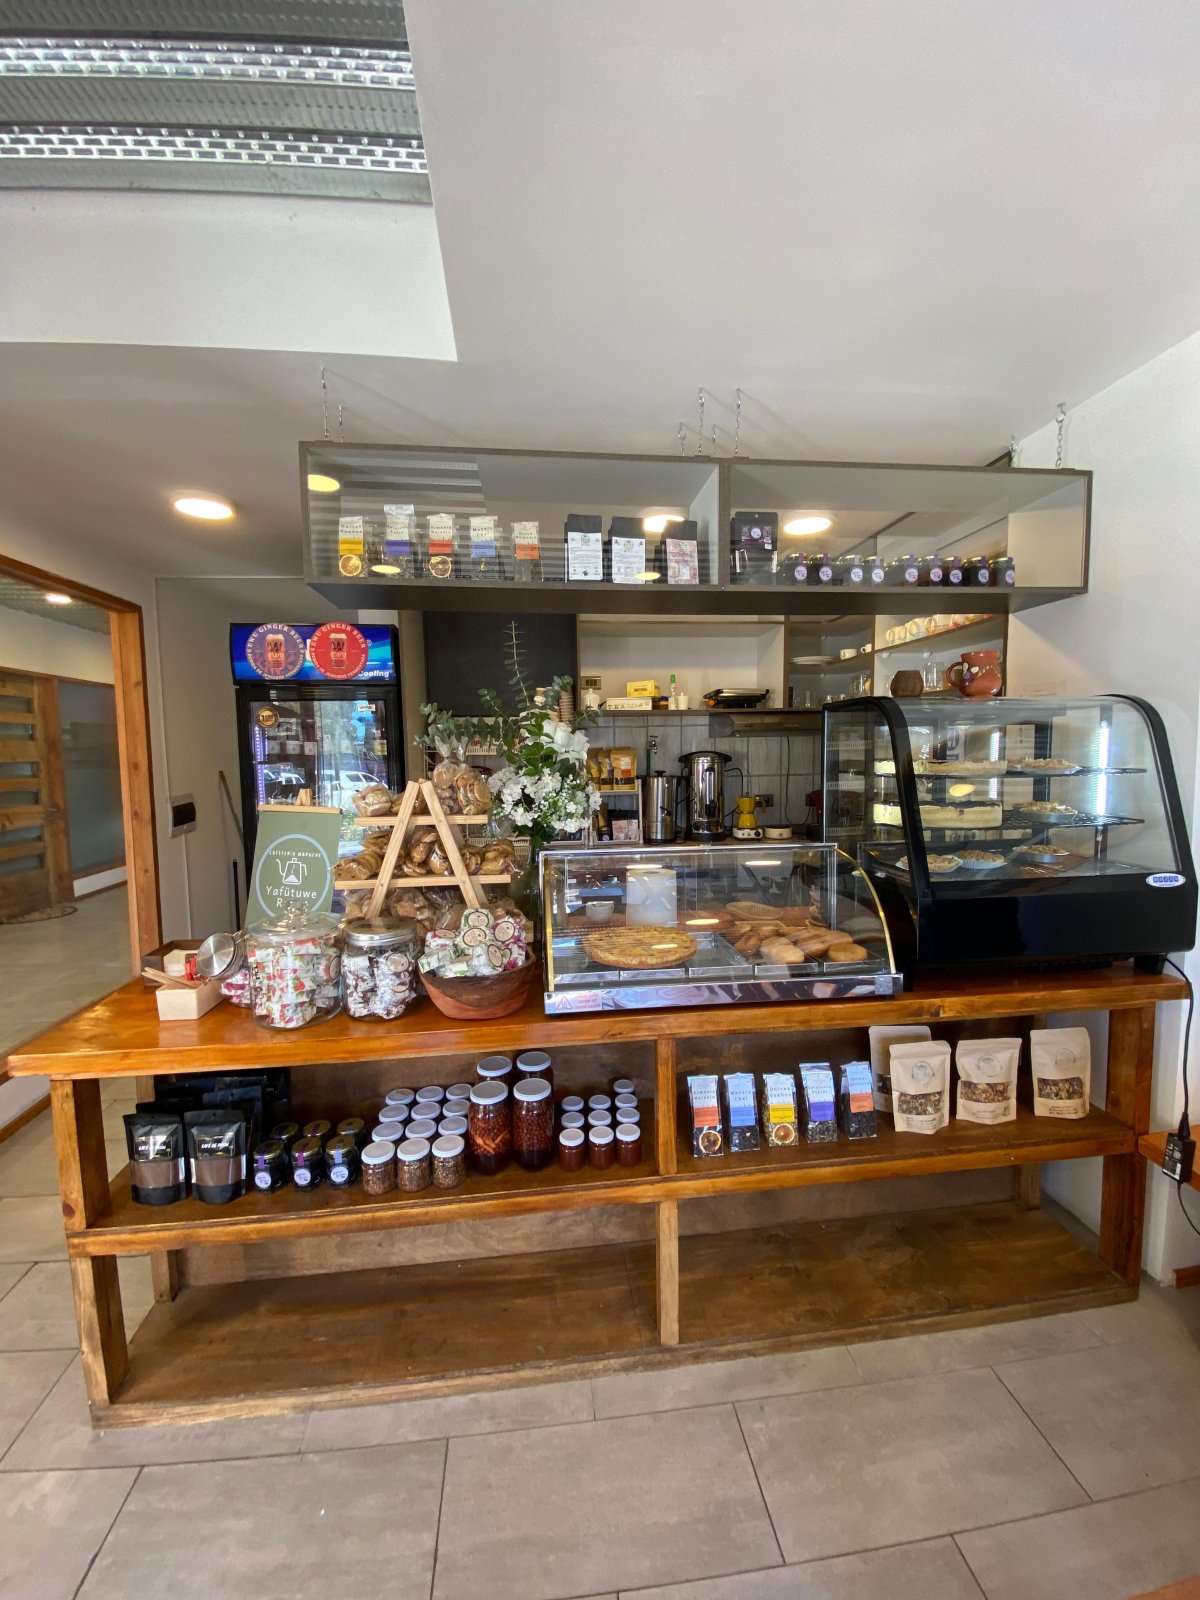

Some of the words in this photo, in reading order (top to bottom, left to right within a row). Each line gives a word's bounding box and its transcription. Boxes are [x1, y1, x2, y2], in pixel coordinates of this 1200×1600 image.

[258, 623, 289, 633] GINGER
[289, 630, 305, 649] BEER
[322, 623, 352, 632] GINGER
[352, 630, 367, 649] BEER
[266, 885, 317, 899] Yafütuwe
